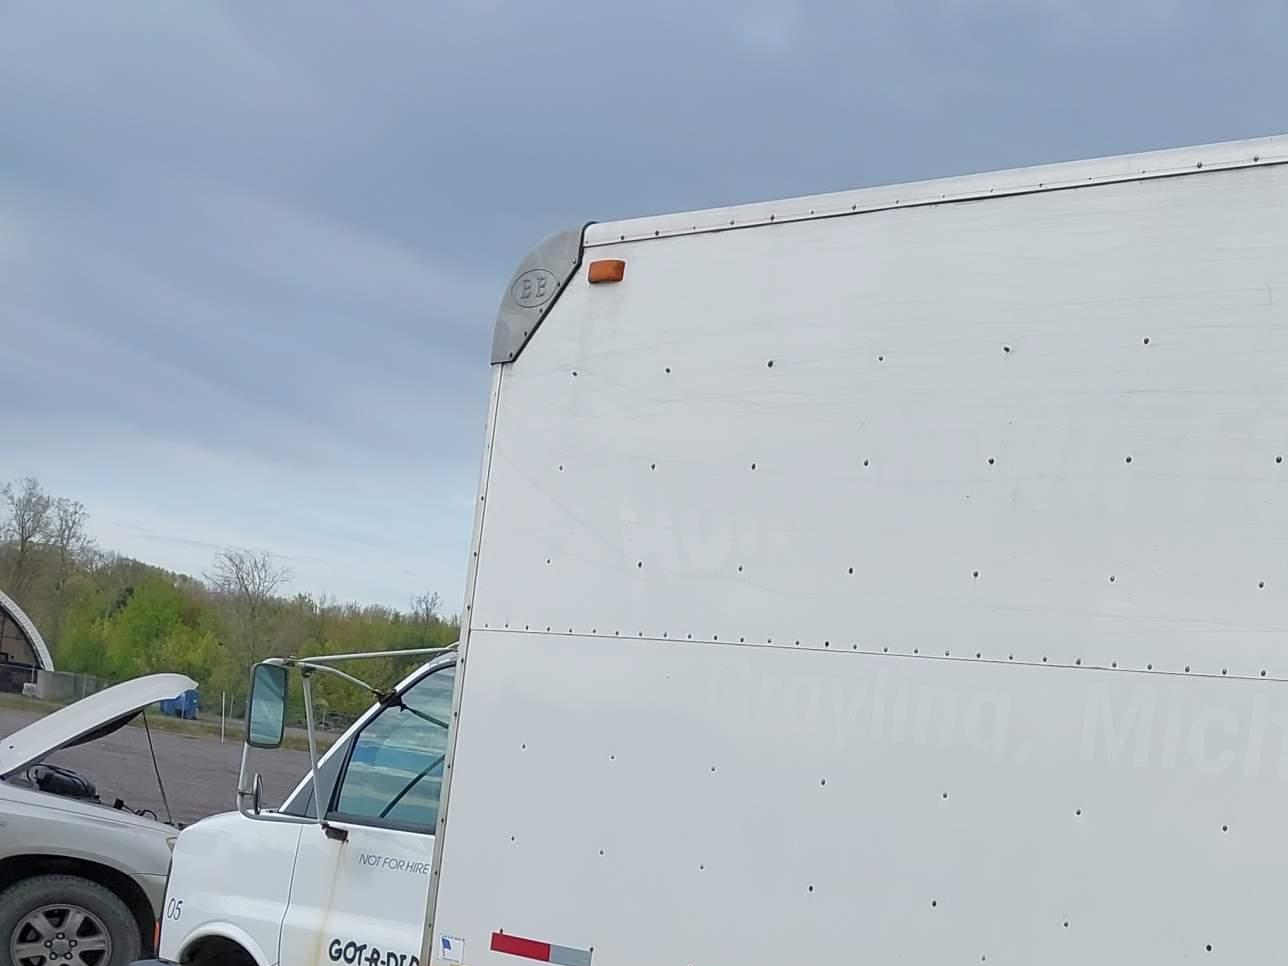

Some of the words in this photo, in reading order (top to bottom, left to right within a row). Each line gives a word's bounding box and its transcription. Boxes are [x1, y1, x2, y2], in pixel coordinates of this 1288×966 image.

[359, 853, 382, 867] NOT
[382, 857, 405, 871] FOR
[405, 861, 430, 875] HIRE
[167, 898, 183, 921] 05
